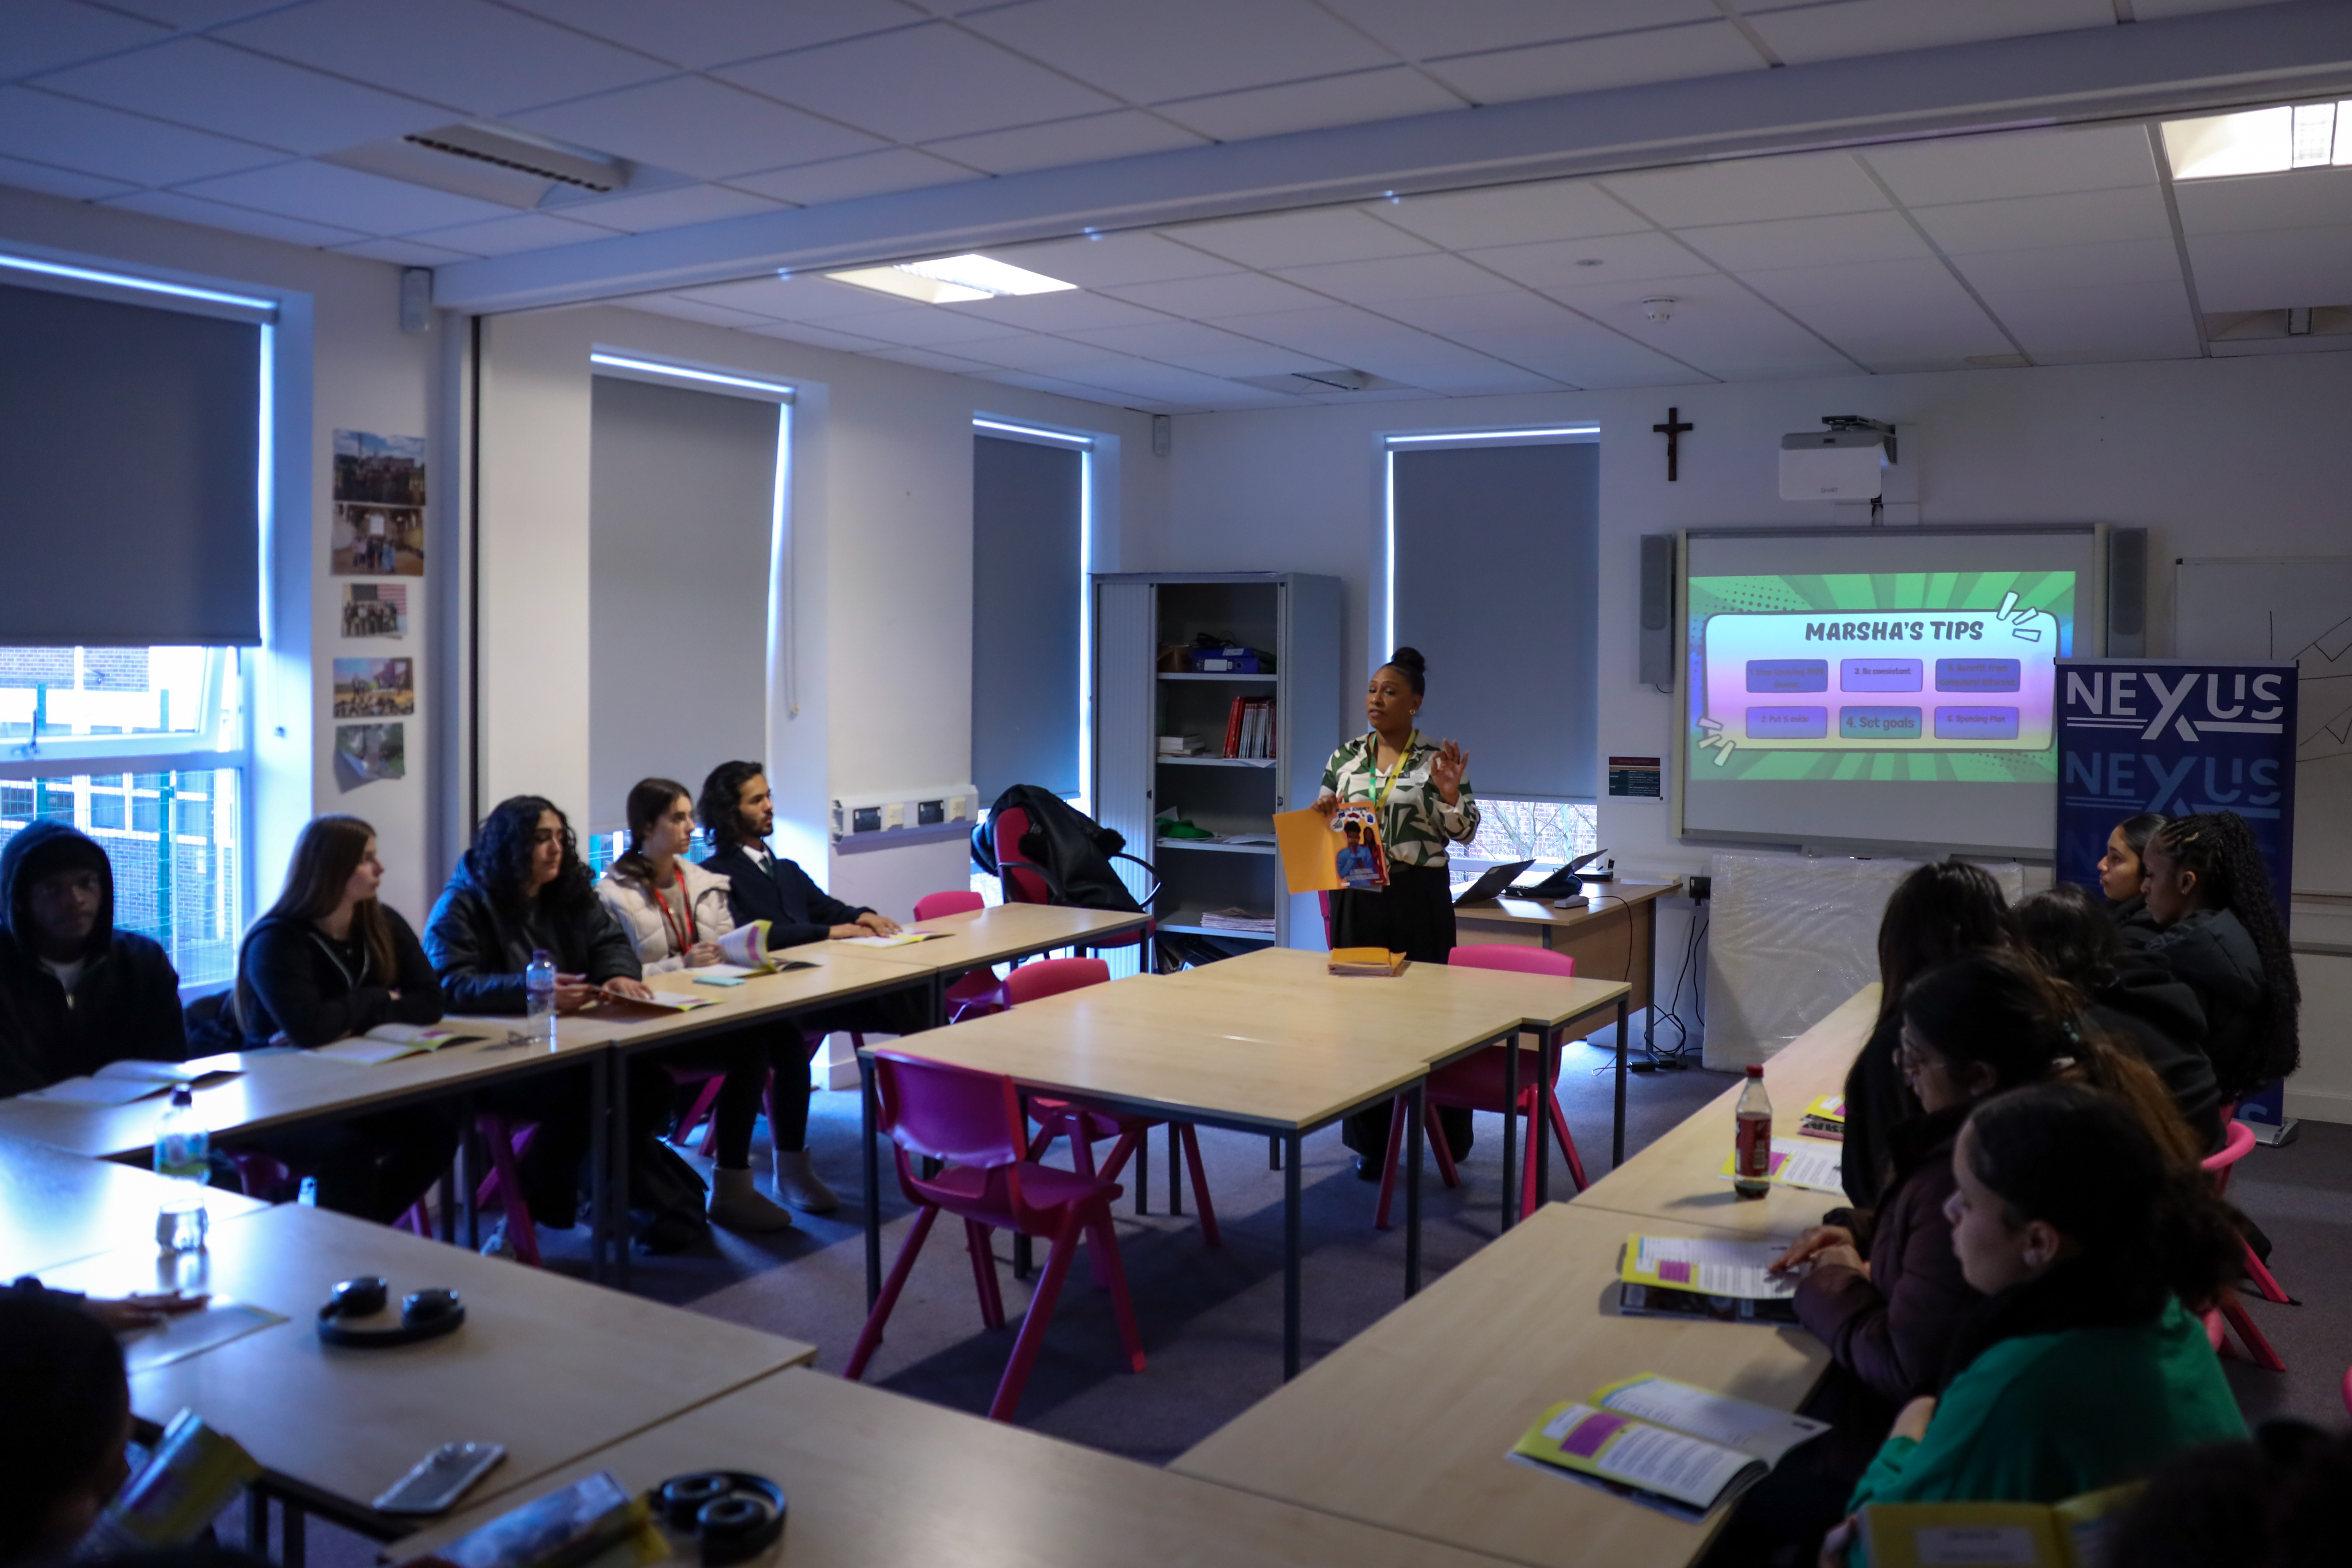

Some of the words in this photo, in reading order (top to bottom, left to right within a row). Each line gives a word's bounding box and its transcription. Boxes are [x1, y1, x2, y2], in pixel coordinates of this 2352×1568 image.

[1805, 621, 1924, 641] MARSHA'S
[1930, 621, 1984, 640] TIPS
[1940, 678, 1980, 687] compound
[2066, 671, 2283, 741] NEXUS
[1846, 716, 1856, 728] 4.
[1859, 716, 1880, 728] Set
[1883, 716, 1915, 731] goals
[1956, 715, 1988, 724] Spending
[2065, 751, 2281, 817] NEXUS
